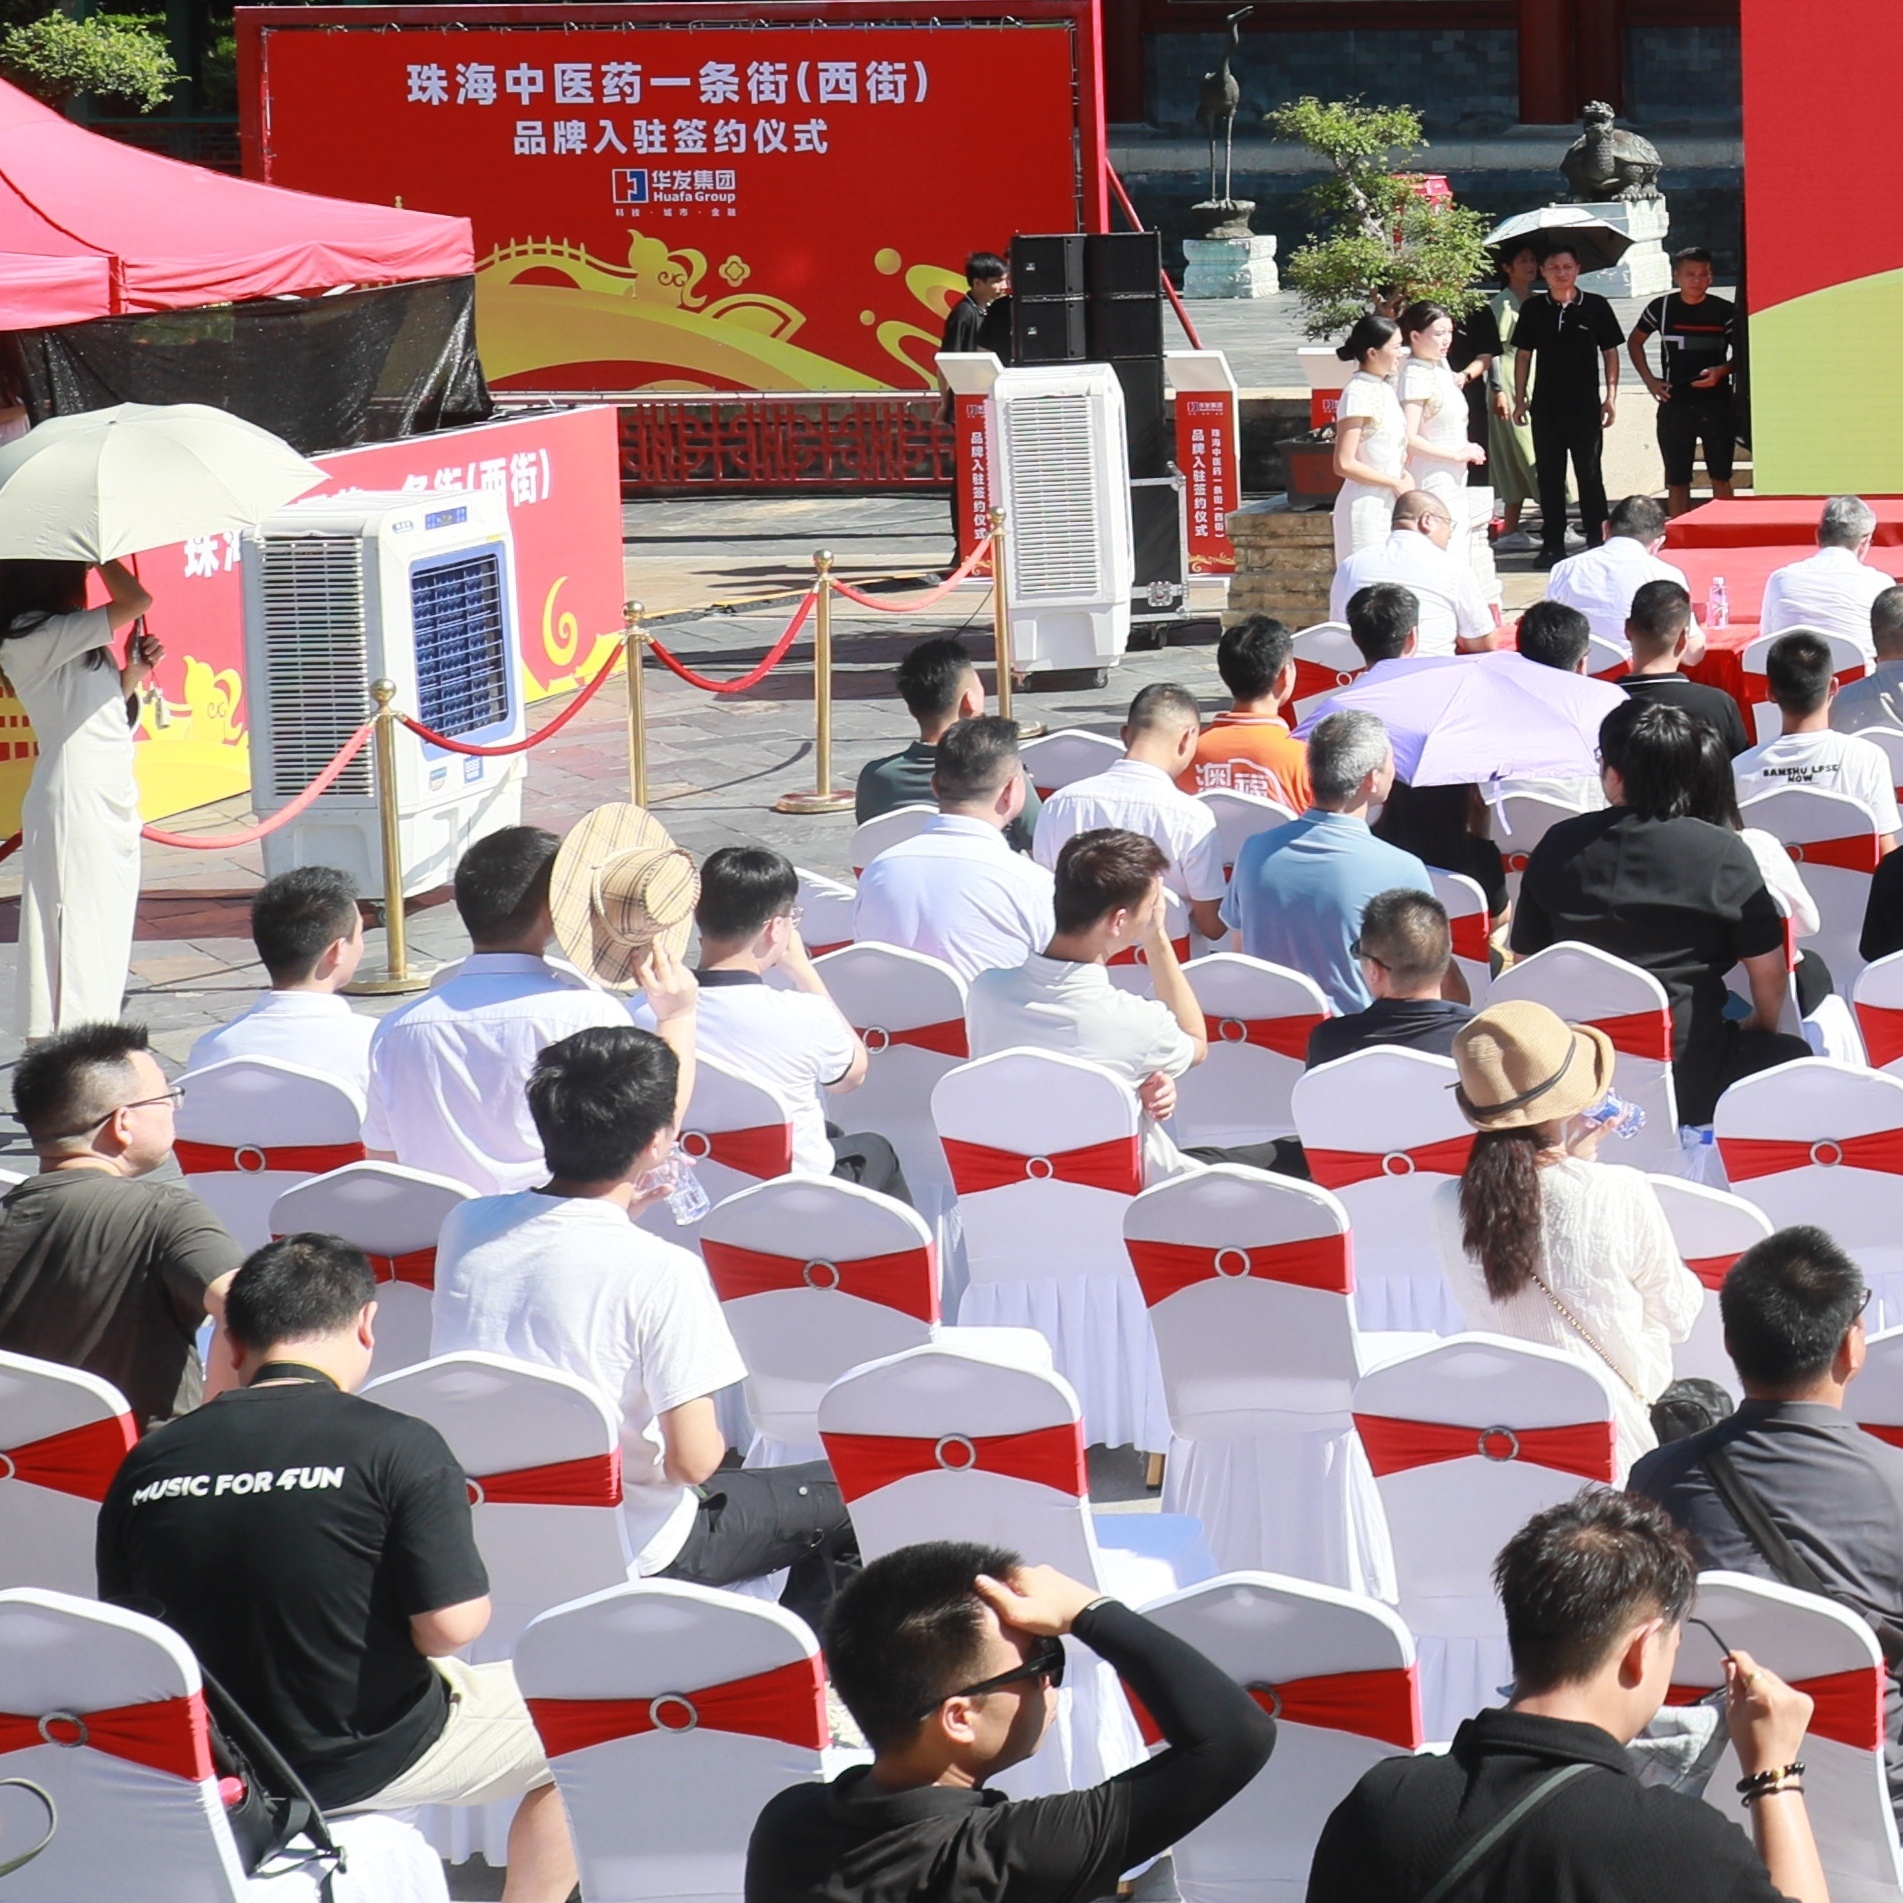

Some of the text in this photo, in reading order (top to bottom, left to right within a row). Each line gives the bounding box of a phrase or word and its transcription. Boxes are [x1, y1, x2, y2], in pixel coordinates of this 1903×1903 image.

[406, 60, 928, 105] 珠海中医药一条街(西街)
[513, 118, 829, 155] 品牌入驻签约仪式
[651, 169, 736, 190] 华发集团
[653, 191, 736, 204] Huafa Group
[132, 1475, 211, 1507] MUSIC
[214, 1471, 275, 1496] FOR
